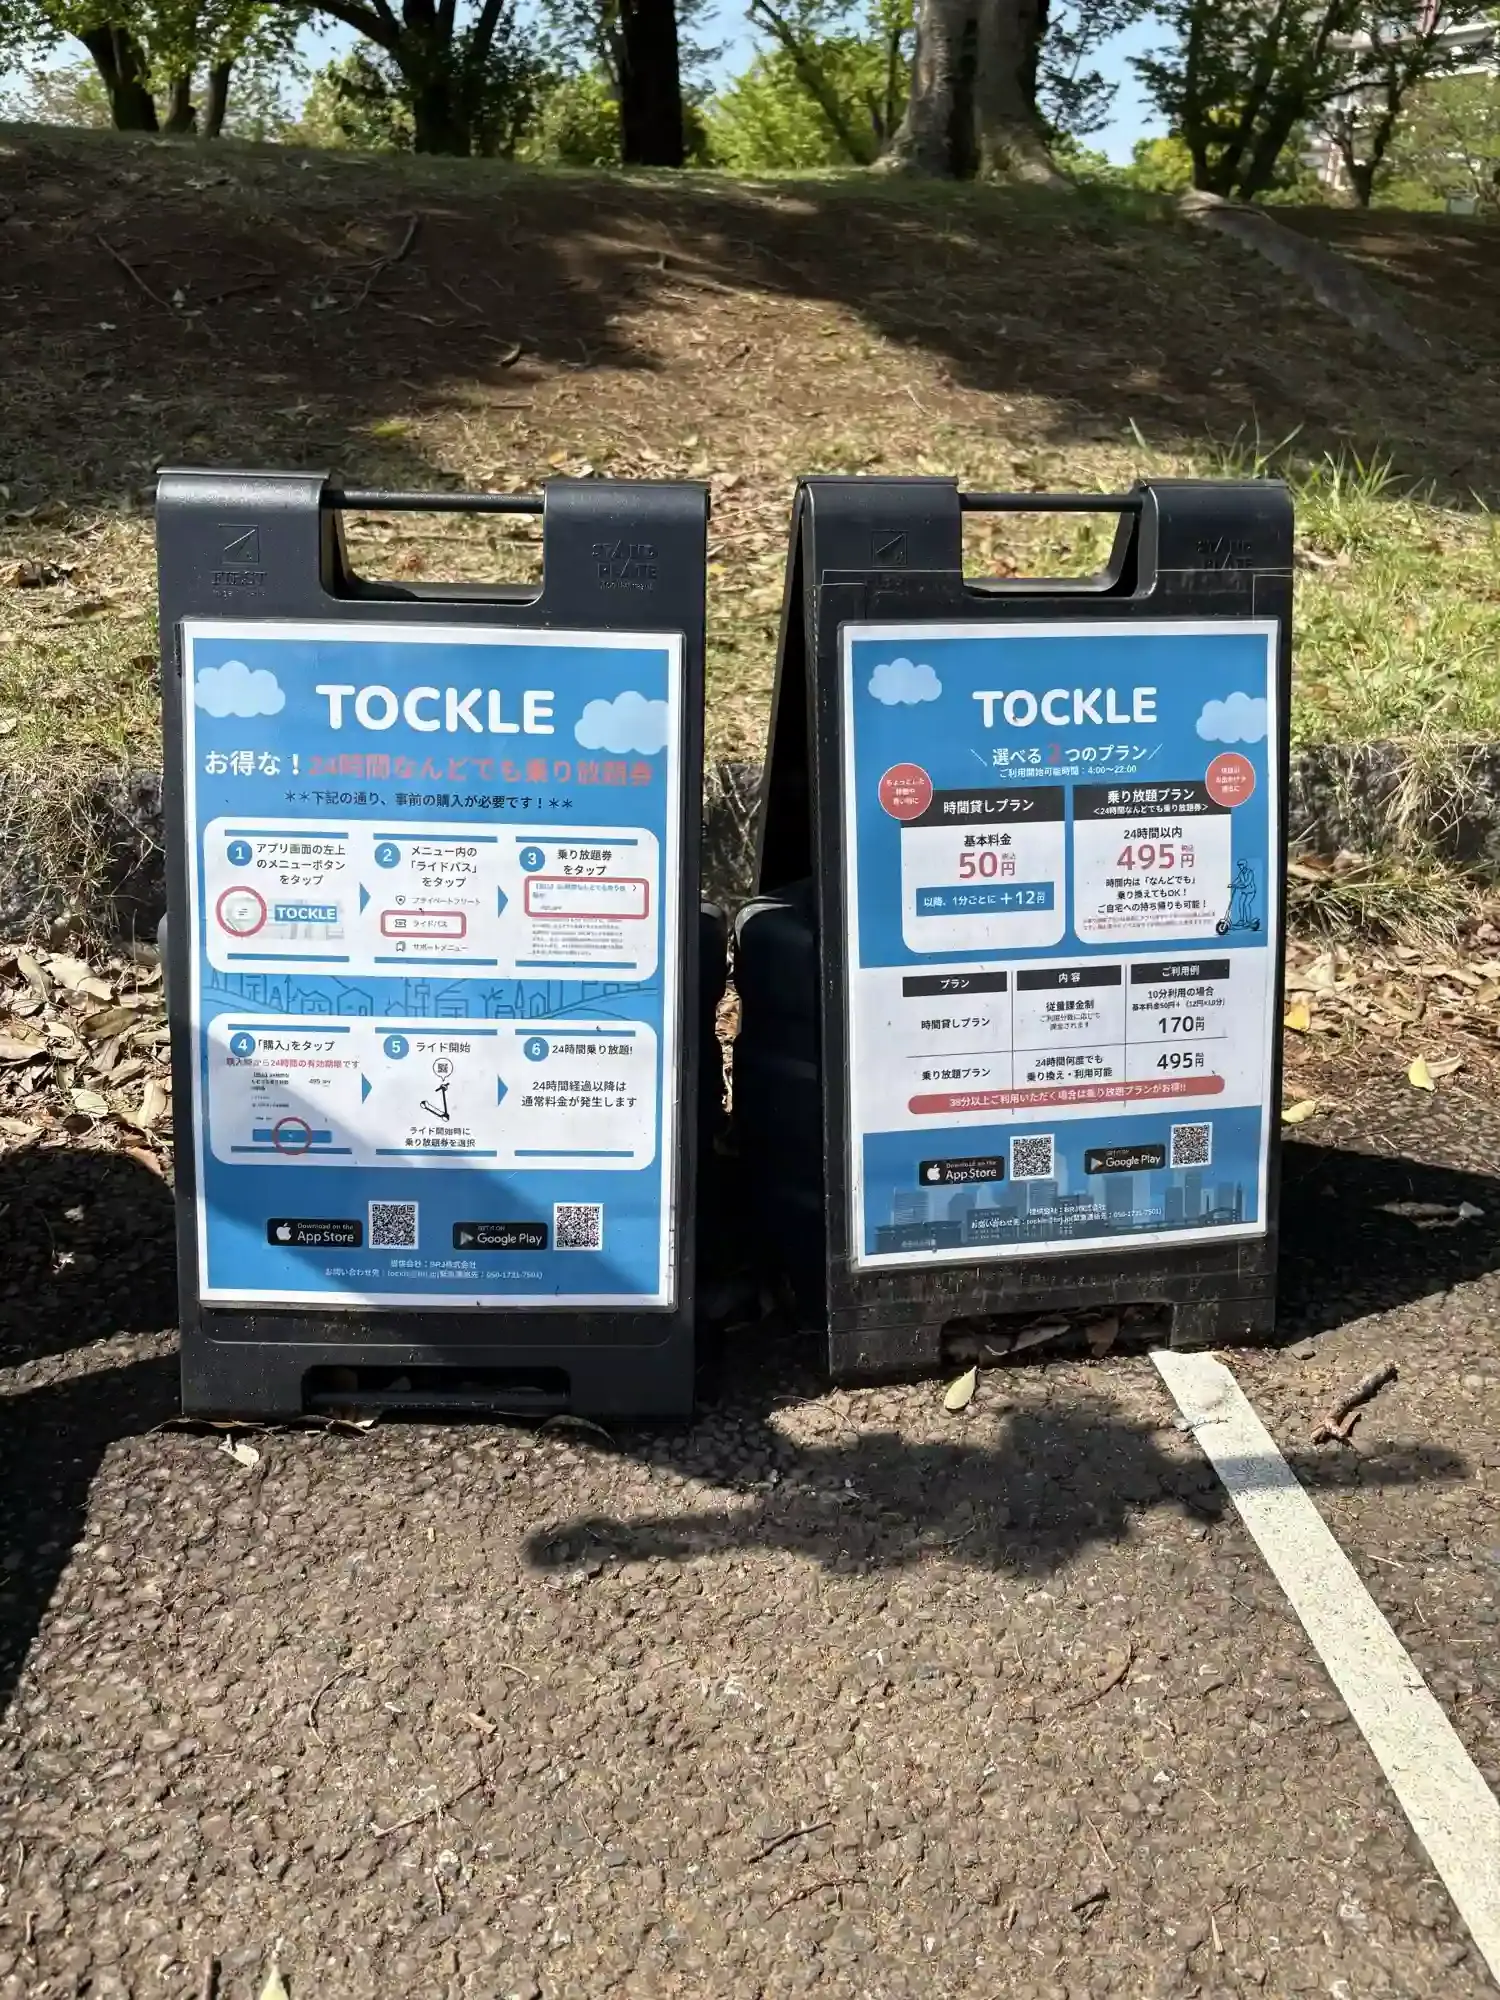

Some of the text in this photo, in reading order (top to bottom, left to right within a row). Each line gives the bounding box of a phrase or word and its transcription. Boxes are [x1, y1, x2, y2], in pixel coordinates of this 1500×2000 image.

[315, 684, 555, 734] TOCKLE
[972, 687, 1157, 728] TOCKLE
[1107, 788, 1195, 804] 乗り放題プラン
[943, 799, 1034, 815] 時間貸しプラン
[1123, 826, 1183, 839] 24時間以内
[964, 833, 1012, 847] 基本料金
[256, 842, 346, 855] アプリ画面の左上
[411, 846, 477, 857] メニュー内の
[382, 849, 393, 862] 2
[527, 852, 537, 866] 3
[557, 850, 612, 861] 乗り放題券
[1116, 843, 1195, 870] 495円
[256, 859, 346, 870] のメニューボタン
[563, 865, 607, 876] をタップ
[959, 851, 1015, 878] 50円
[279, 874, 324, 886] をタップ
[422, 877, 466, 888] をタップ
[276, 907, 336, 919] TOCKLE
[1161, 965, 1200, 977] ご利用例
[940, 979, 970, 989] プラン
[1147, 987, 1214, 999] 10分利用の場合
[1046, 998, 1095, 1012] 従量課金制
[921, 1017, 990, 1030] 時間貸しプラン
[238, 1038, 249, 1051] 4
[258, 1039, 336, 1051] 「購入」をタップ
[391, 1040, 401, 1053] 5
[416, 1042, 471, 1053] ライド開始
[531, 1043, 541, 1056] 6
[1035, 1054, 1104, 1067] 24時間何度でも
[922, 1069, 991, 1081] 乗り放題プラン
[532, 1081, 627, 1092] 24時間経過以降は
[521, 1096, 637, 1108] 通常料金が発生します
[1106, 1154, 1161, 1169] Google Play
[945, 1168, 997, 1181] App Store
[297, 1231, 354, 1244] App Store
[477, 1233, 542, 1246] Google Play
